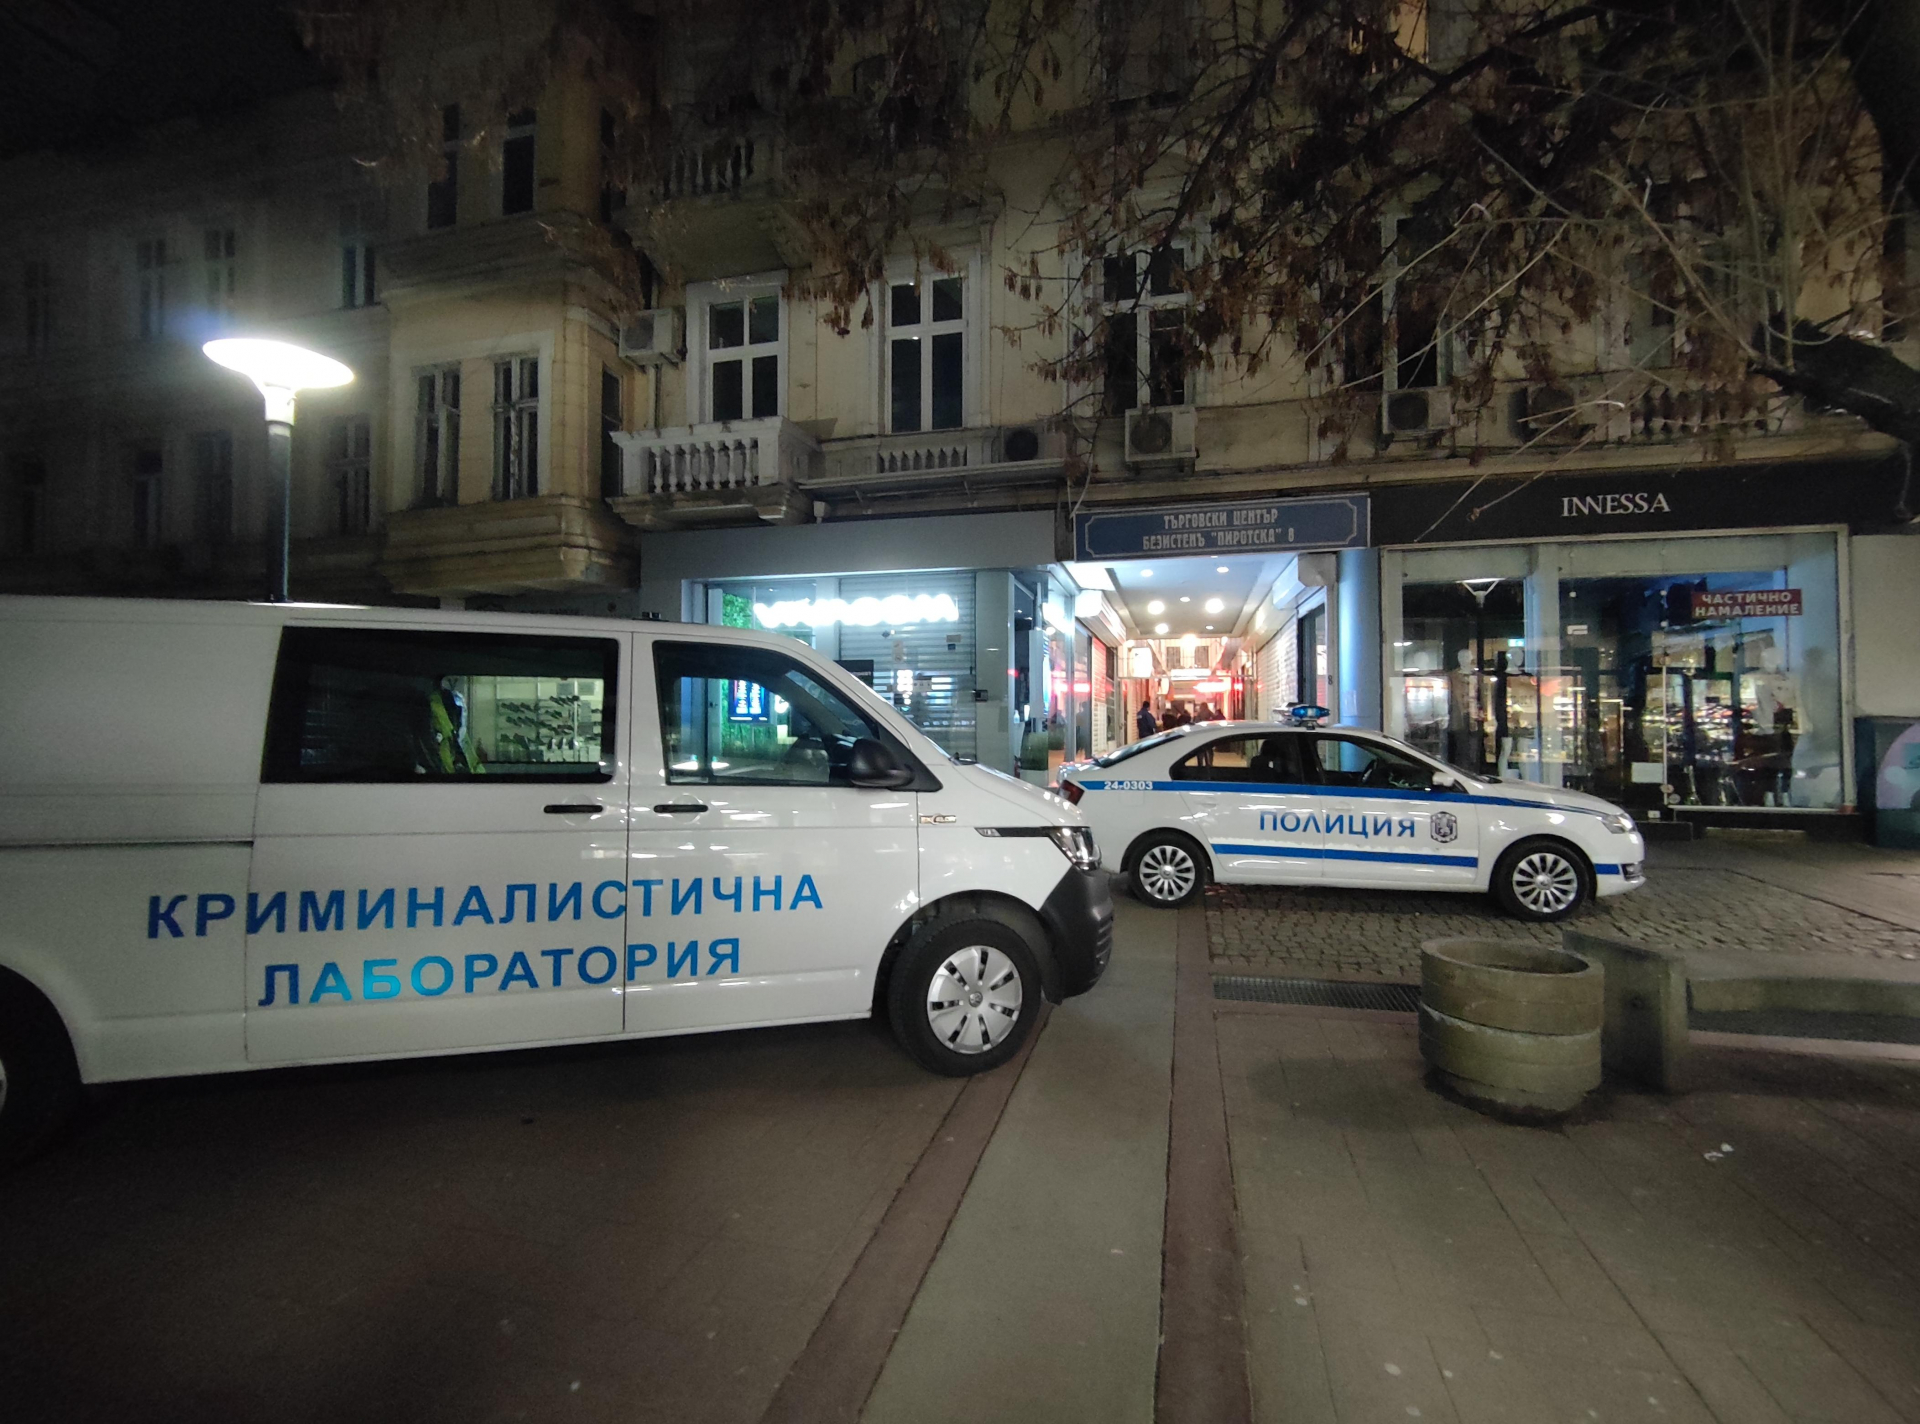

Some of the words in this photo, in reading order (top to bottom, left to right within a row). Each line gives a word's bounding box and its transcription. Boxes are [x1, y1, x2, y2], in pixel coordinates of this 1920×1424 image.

[1561, 492, 1671, 517] INNESSA
[1163, 511, 1227, 529] ТЪРГОВСКИ
[1233, 509, 1278, 525] ЦЕНТЪР
[1702, 591, 1792, 605] ЧАСТИЧНО
[1695, 603, 1800, 617] НАМАЛЕНИЕ
[1104, 780, 1154, 791] 24-0303
[1260, 811, 1415, 839] ПОЛИЦИЯ
[147, 874, 824, 939] КРИМИНАЛИСТИЧНА
[257, 937, 741, 1007] ЛАБОРАТОРИЯ
